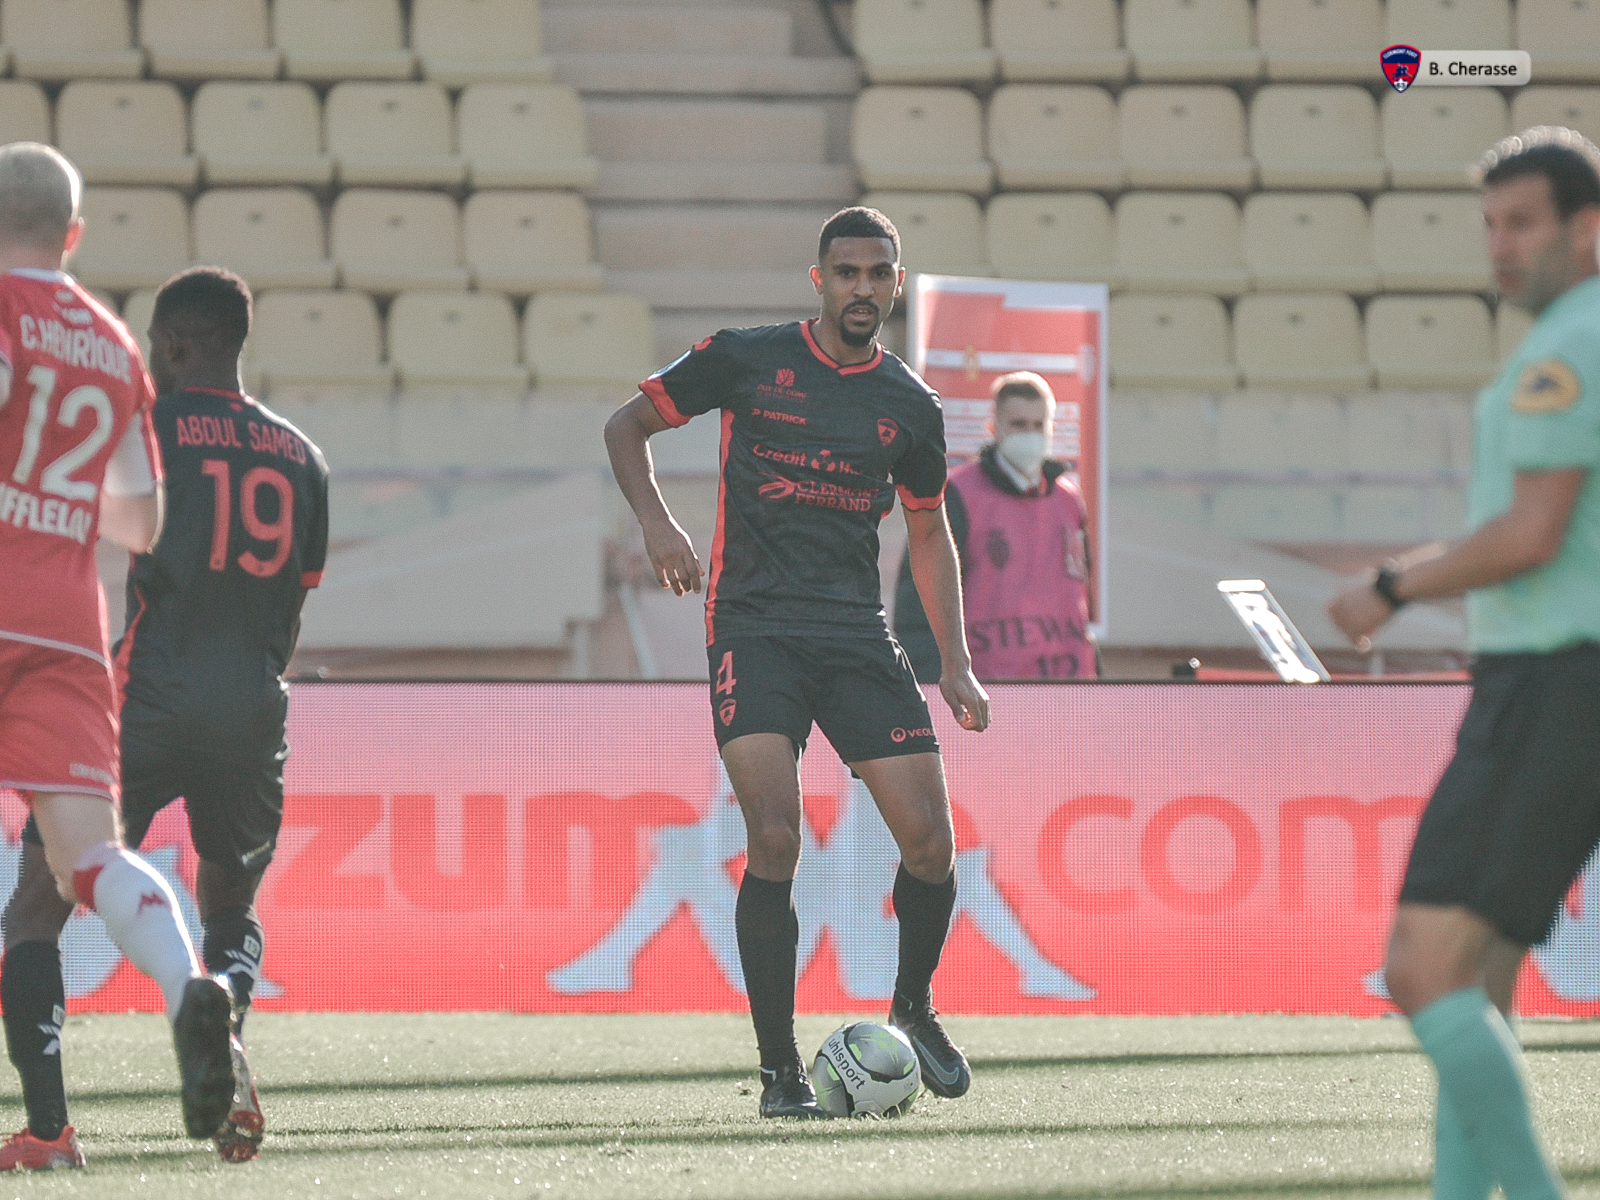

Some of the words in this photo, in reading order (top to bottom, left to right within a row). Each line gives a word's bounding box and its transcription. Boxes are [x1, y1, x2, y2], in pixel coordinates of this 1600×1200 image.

[13, 364, 113, 503] 12
[763, 409, 807, 426] PATRICK
[248, 420, 307, 466] SAMED
[202, 459, 294, 578] 19
[794, 492, 872, 513] FERRAND
[968, 616, 1085, 654] STEWA
[715, 650, 737, 695] 4
[907, 727, 935, 738] VEOL
[828, 1038, 866, 1090] uhlsport
